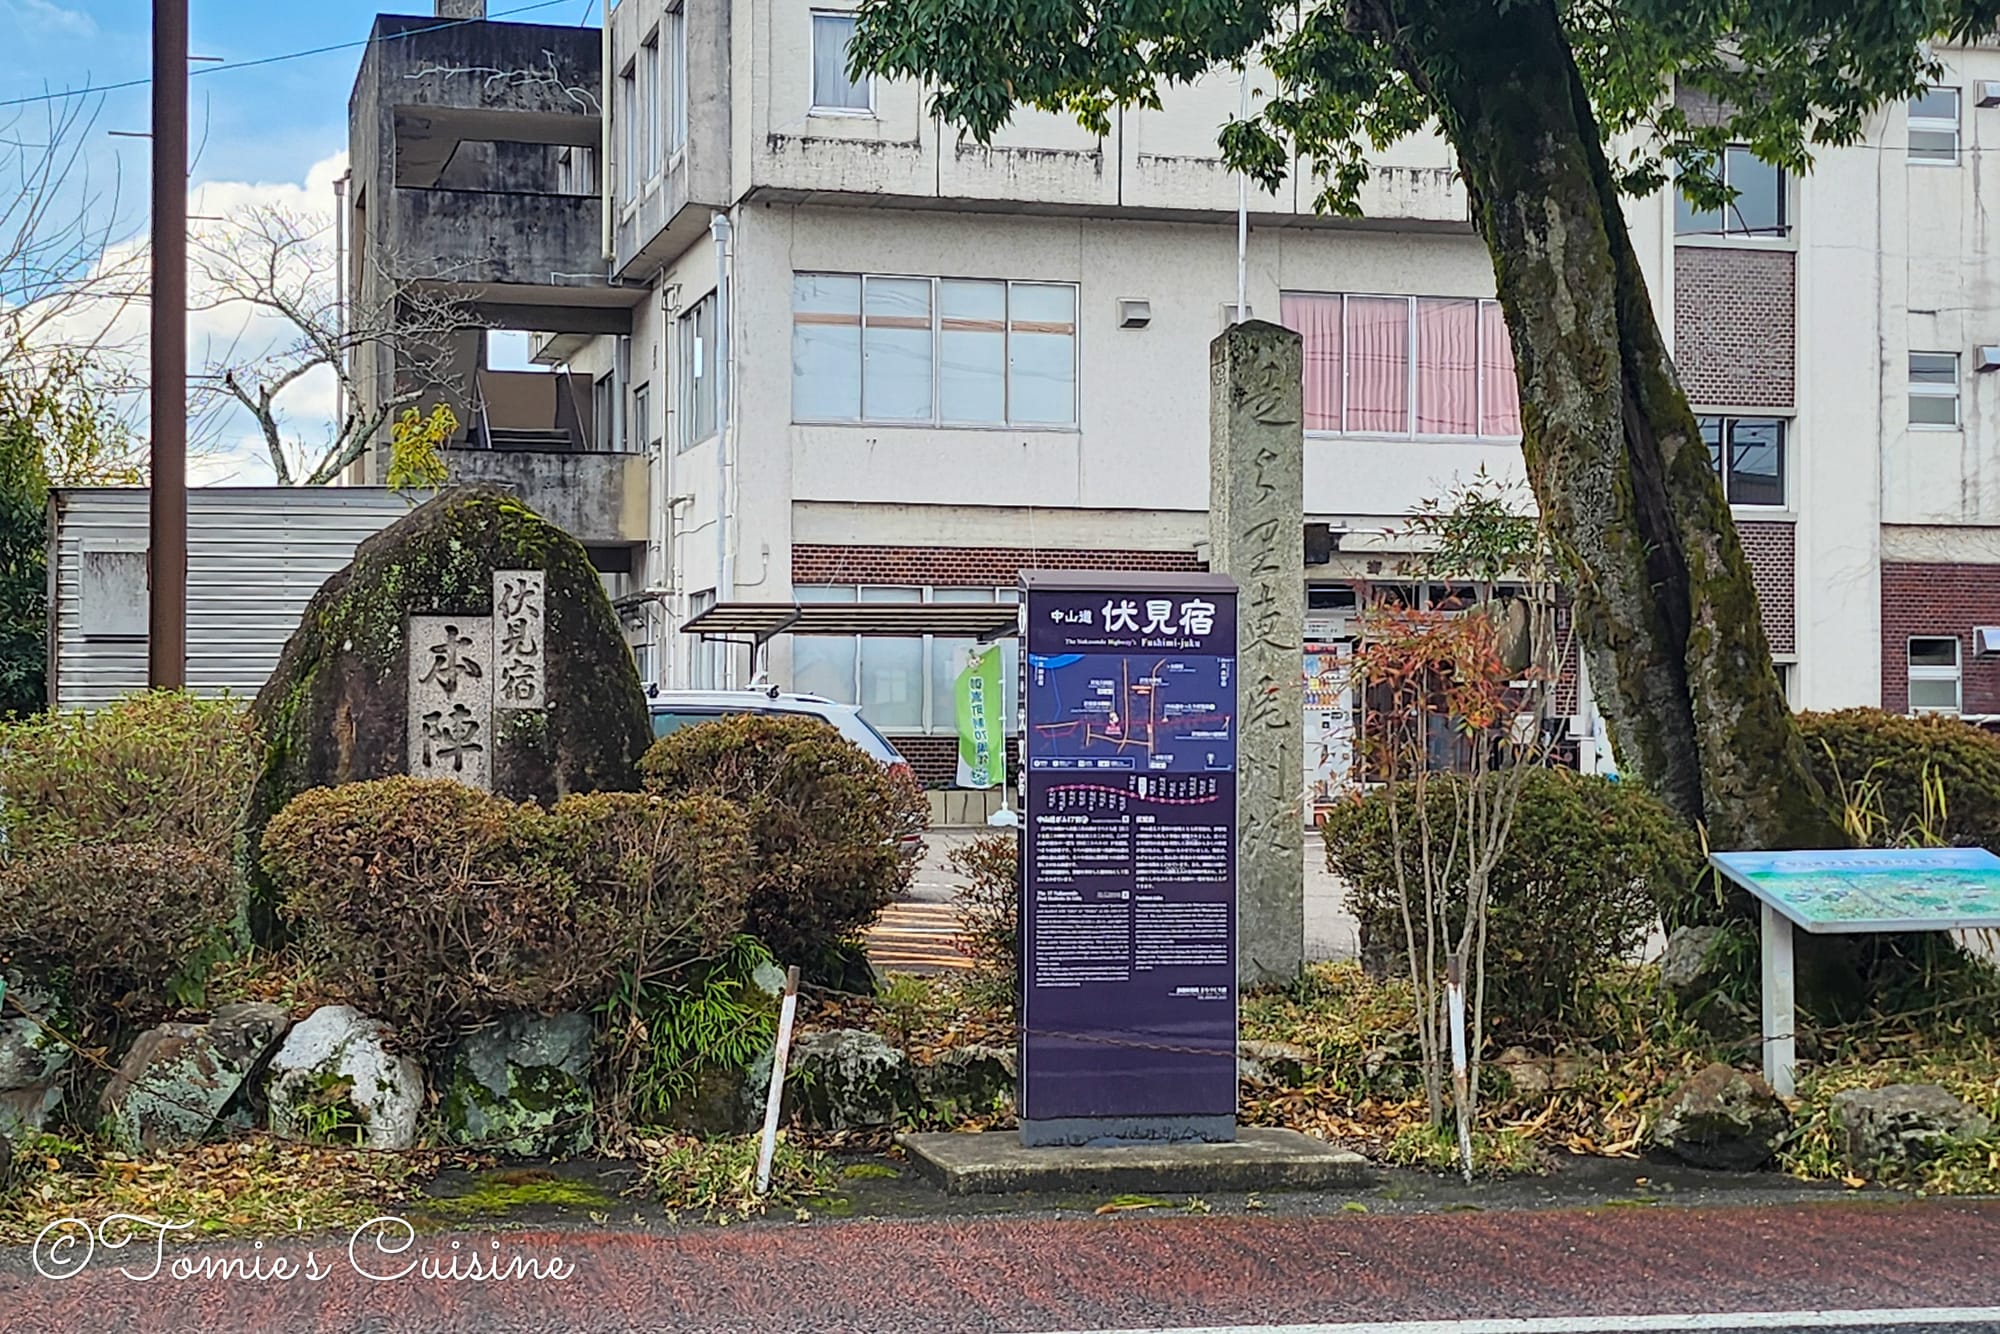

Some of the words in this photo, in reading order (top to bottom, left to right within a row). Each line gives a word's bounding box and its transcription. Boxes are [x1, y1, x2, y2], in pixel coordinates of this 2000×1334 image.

[497, 577, 541, 704] 伏見宿
[1050, 609, 1093, 625] 中山道
[1101, 598, 1216, 635] 伏見宿
[1141, 637, 1201, 649] Fushimi-juku
[418, 624, 484, 773] 本陣
